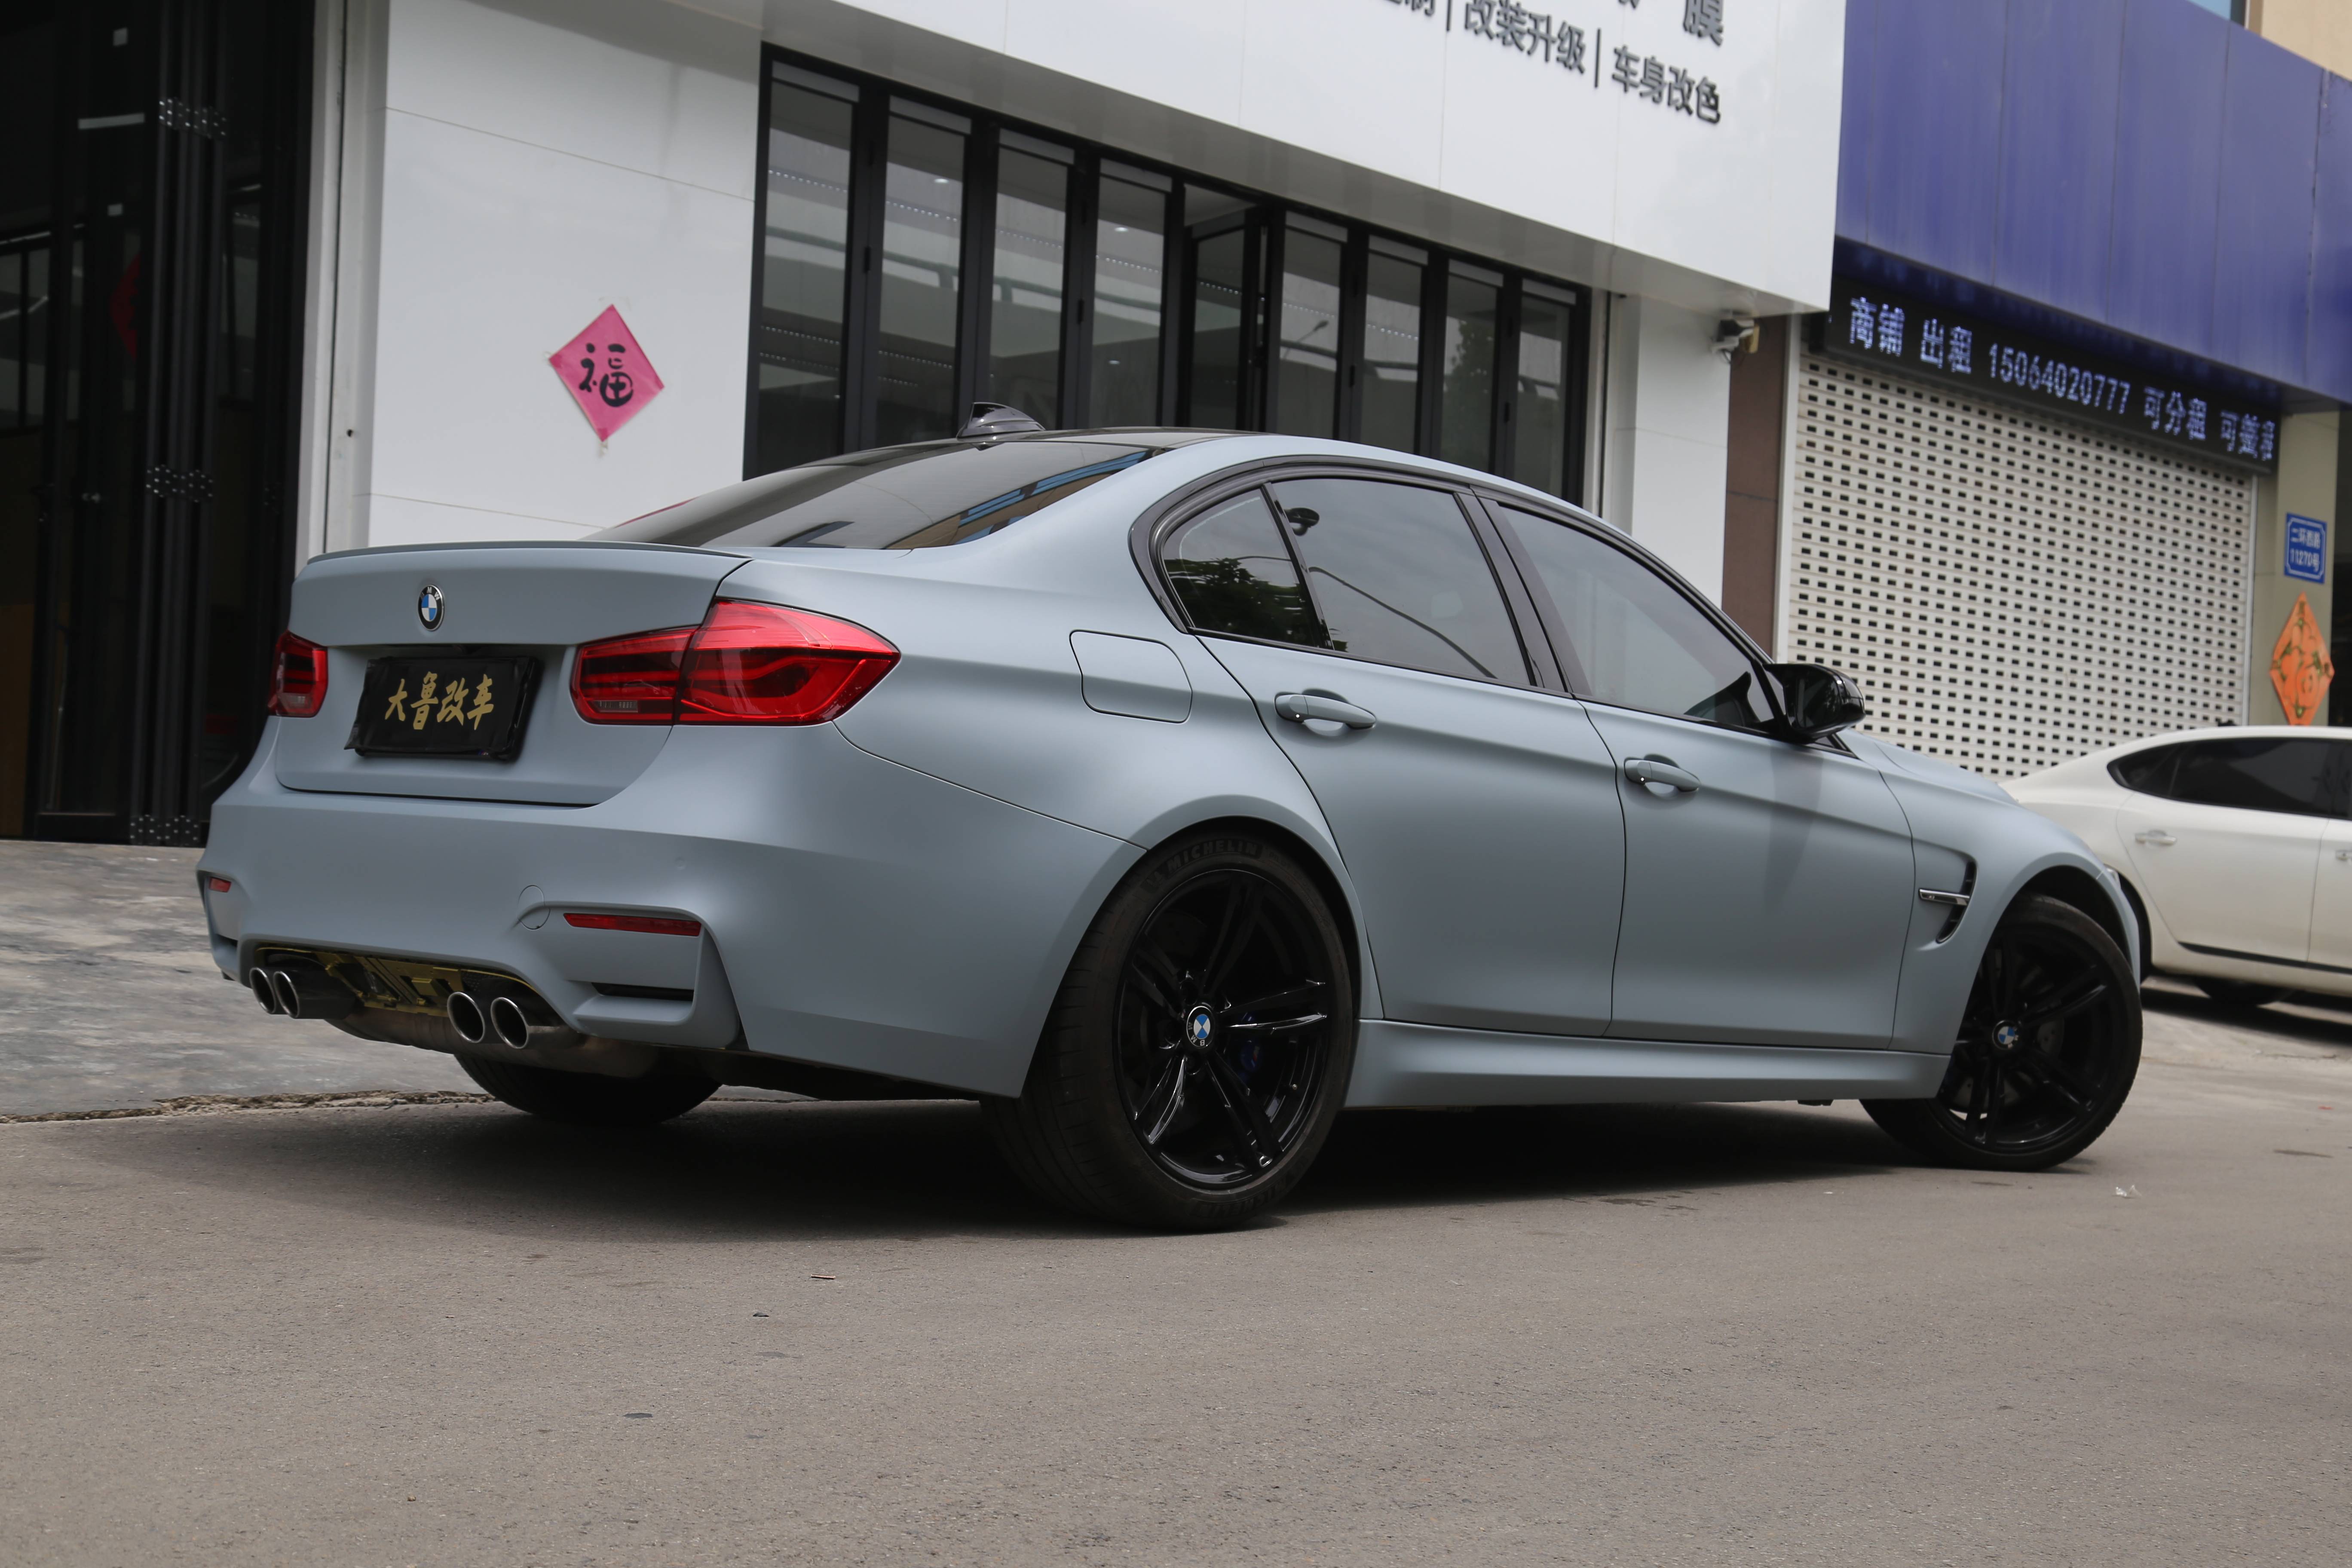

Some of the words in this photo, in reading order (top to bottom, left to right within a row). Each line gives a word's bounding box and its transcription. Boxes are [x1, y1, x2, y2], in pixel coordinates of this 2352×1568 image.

[1464, 0, 1586, 74] 改装升级
[1612, 45, 1720, 124] 车身改色
[579, 343, 634, 407] 福
[1850, 297, 1905, 357] 商铺
[1920, 318, 1972, 374] 出租
[1989, 343, 2131, 414] 15064020777
[2144, 386, 2207, 441] 可分租
[384, 671, 494, 730] 大鲁改车
[1167, 839, 1258, 872] MICHELIN
